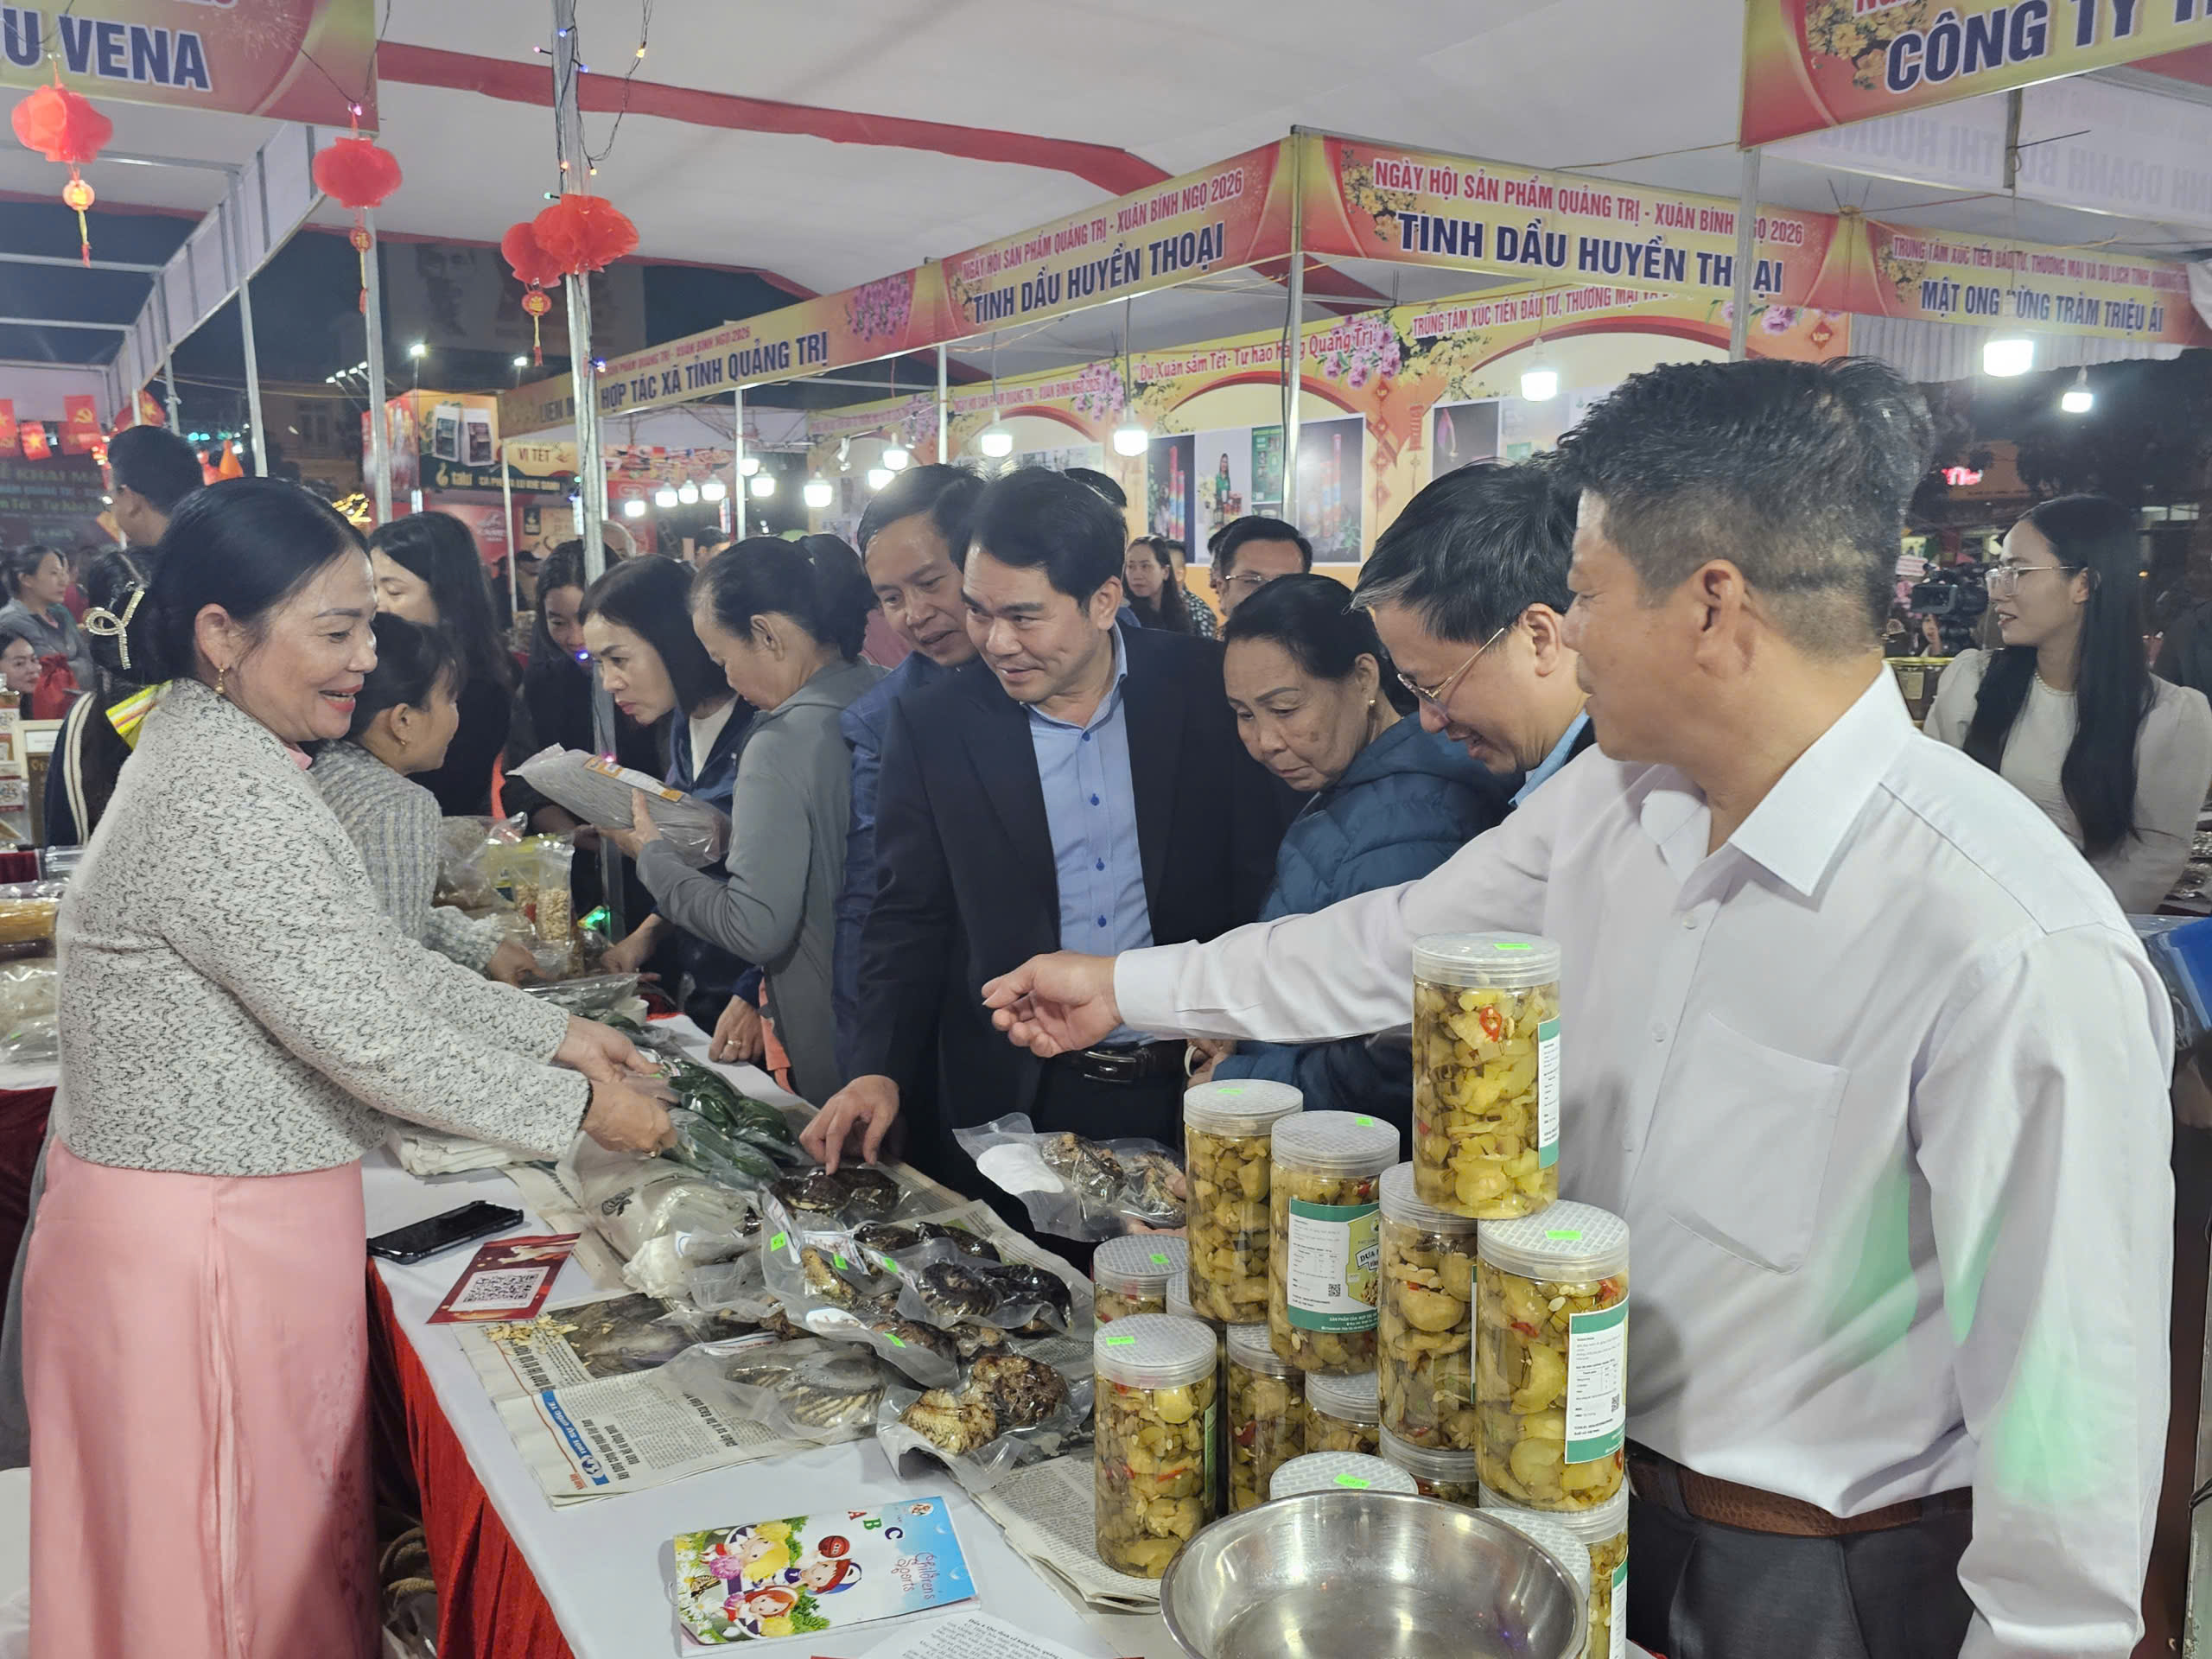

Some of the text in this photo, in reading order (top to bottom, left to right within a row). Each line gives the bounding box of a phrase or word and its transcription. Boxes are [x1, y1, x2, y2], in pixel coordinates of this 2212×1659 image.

[59, 16, 211, 91] VENA
[1886, 0, 2049, 92] CÔNG
[962, 253, 985, 283] NGÀY
[987, 249, 1001, 276] HỘI
[1004, 242, 1022, 270] SẢN
[1024, 230, 1052, 264] PHẨM
[1054, 221, 1088, 255] QUẢNG
[1090, 217, 1107, 243] TRỊ
[1116, 202, 1147, 234] XUÂN
[1150, 194, 1179, 222] BÍNH
[1182, 182, 1207, 211] NGỌ
[1211, 170, 1243, 202] 2026
[1375, 158, 1424, 191] NGÀY
[1429, 166, 1459, 200] HỘI
[1464, 168, 1499, 203] SẢN
[1504, 175, 1554, 210] PHẨM
[1558, 184, 1611, 219] QUẢNG
[1617, 198, 1640, 227] TRỊ
[1654, 201, 1696, 231] XUÂN
[1699, 206, 1734, 235] BÍNH
[1770, 219, 1804, 245] 2026
[974, 222, 1224, 325] TINH DẦU HUYỀN THOẠI
[1397, 213, 1783, 299] TINH DẦU HUYỀN THẠI
[1413, 315, 1445, 338] TRUNG
[1446, 308, 1469, 332] TÂM
[1471, 302, 1492, 327] XÚC
[1493, 297, 1517, 325] TIẾN
[1520, 294, 1541, 320] ĐẦU
[1566, 287, 1611, 313] THƯƠNG
[1921, 276, 2164, 336] MẬT ONG ỪNG TRÀM TRIỆU ÁI
[631, 373, 657, 403] TÁC
[661, 364, 682, 397] XÃ
[685, 354, 723, 389] TỈNH
[728, 338, 791, 382] QUẢNG
[796, 331, 829, 367] TRỊ
